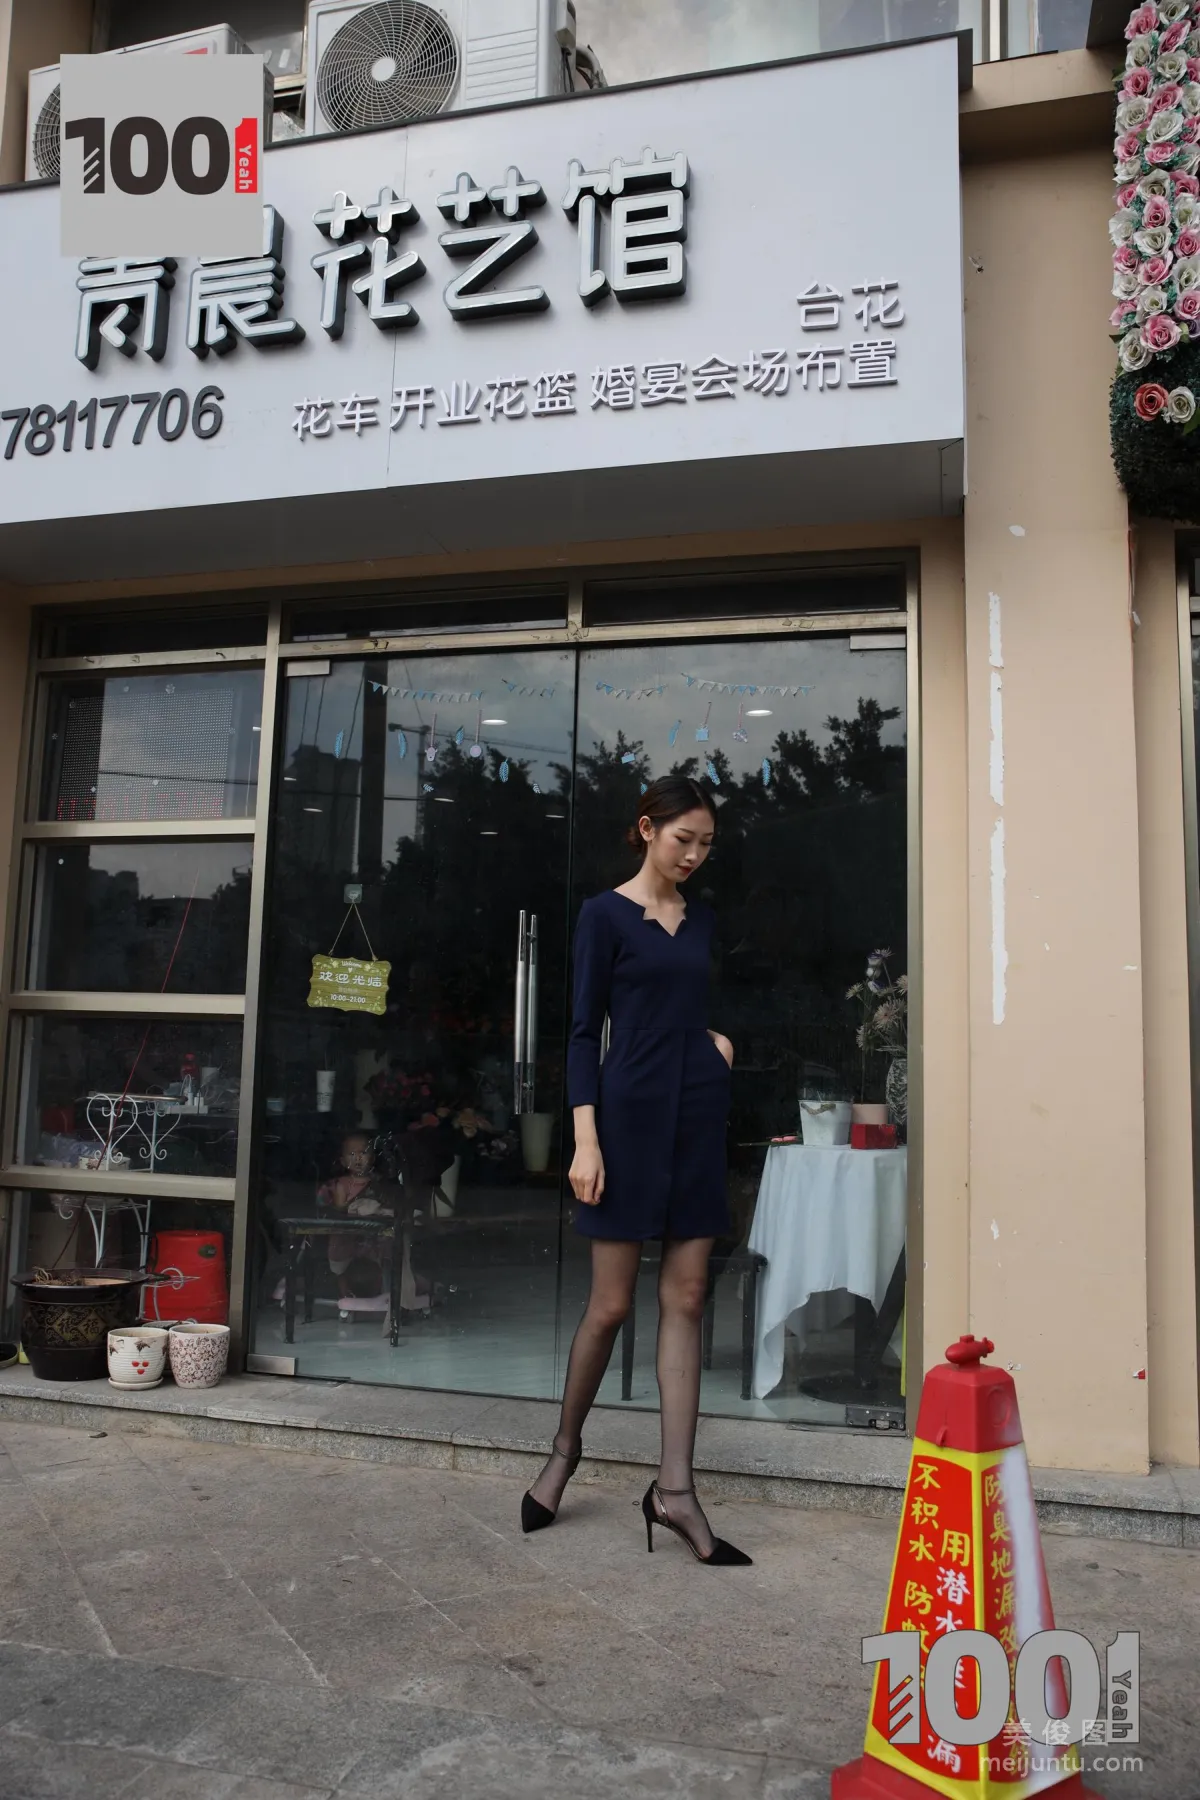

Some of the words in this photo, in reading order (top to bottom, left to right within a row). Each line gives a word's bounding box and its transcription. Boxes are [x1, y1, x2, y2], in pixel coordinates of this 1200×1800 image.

[797, 277, 905, 331] 台花
[319, 971, 382, 987] 欢迎光临
